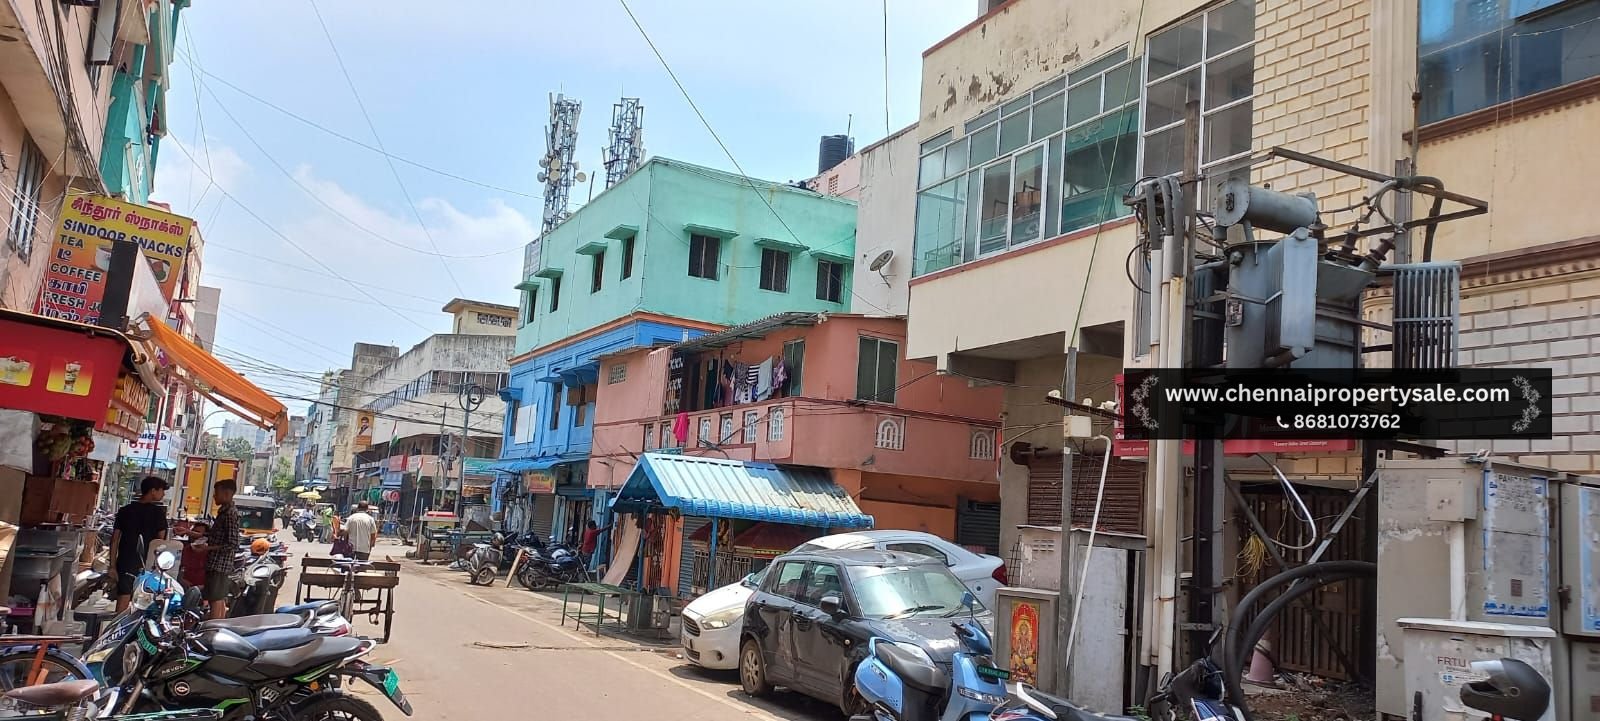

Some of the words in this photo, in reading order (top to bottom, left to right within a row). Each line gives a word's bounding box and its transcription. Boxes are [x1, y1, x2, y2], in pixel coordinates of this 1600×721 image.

[59, 234, 85, 248] TEA
[63, 218, 127, 241] SINDOOR
[130, 235, 183, 258] SNACKS
[50, 263, 102, 282] COFFEE
[42, 291, 86, 309] FRESH
